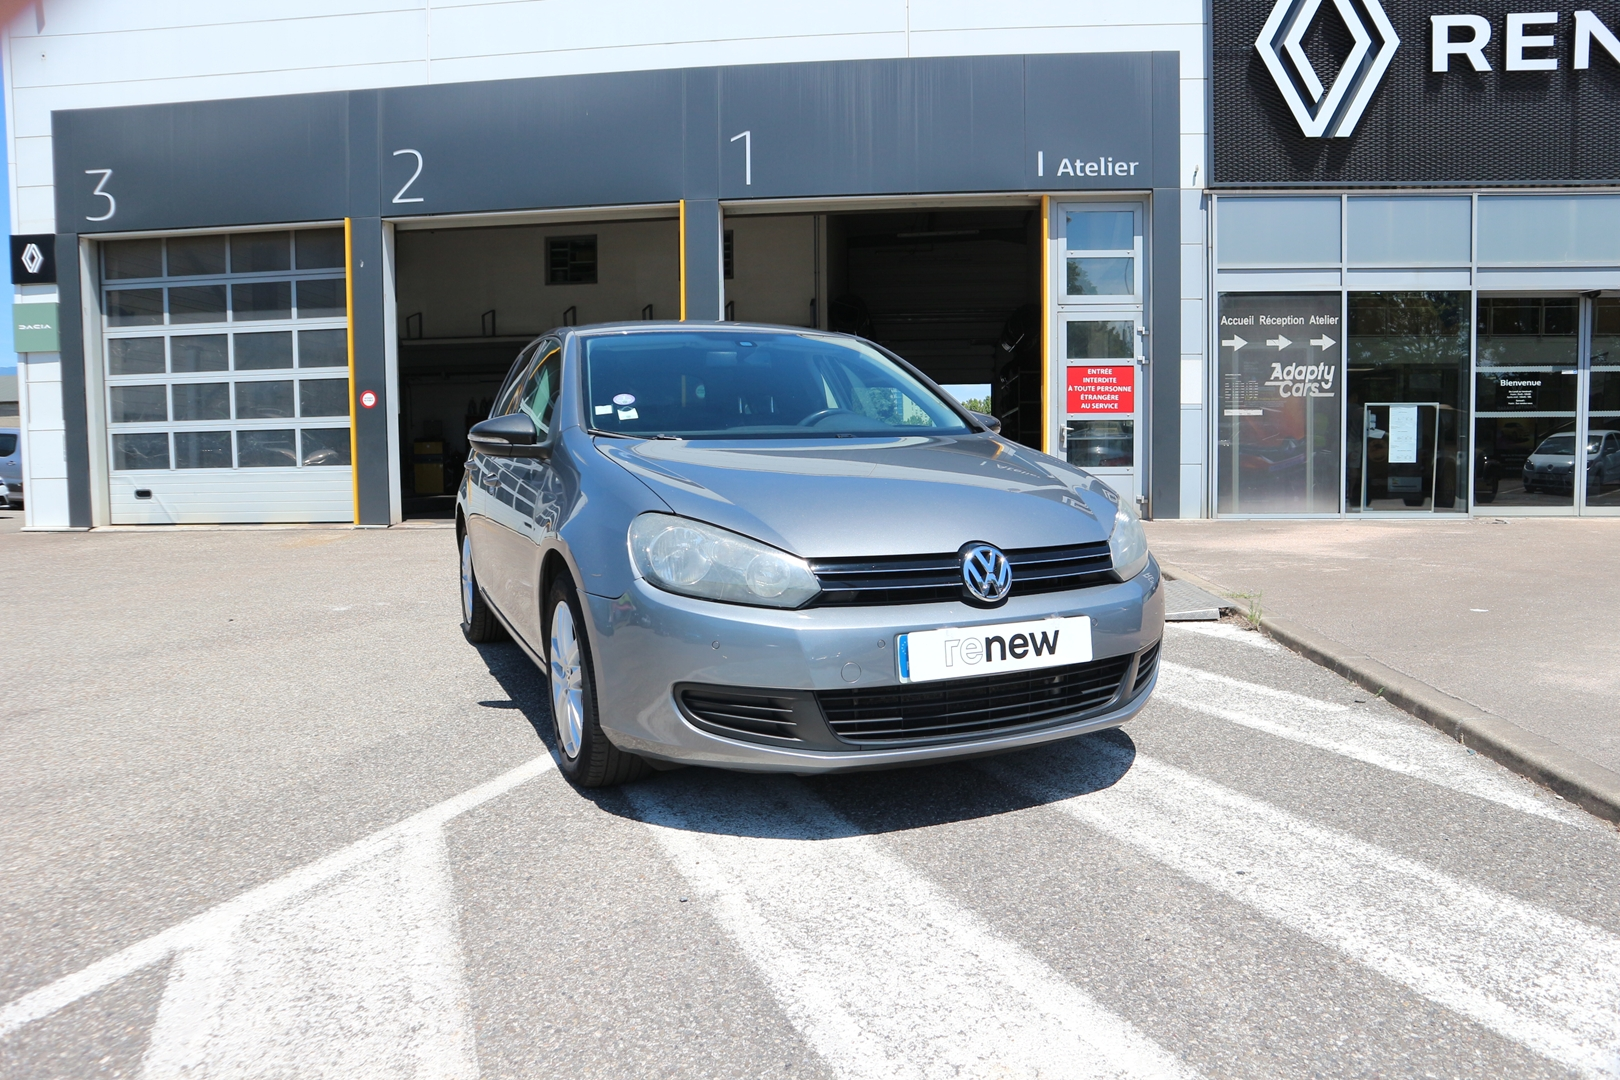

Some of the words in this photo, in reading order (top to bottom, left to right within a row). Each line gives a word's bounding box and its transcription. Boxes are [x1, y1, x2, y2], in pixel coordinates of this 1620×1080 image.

[1430, 9, 1620, 73] REN
[730, 131, 752, 186] 1
[1056, 156, 1140, 177] Atelier
[391, 148, 425, 204] 2
[84, 168, 116, 222] 3
[1220, 315, 1255, 325] Accueil
[1259, 314, 1305, 327] Réception
[1308, 314, 1339, 325] Atelier
[1270, 362, 1335, 389] Adapty
[1501, 379, 1542, 387] Bienvenue
[1080, 393, 1119, 401] ÉTRANGÈRE
[1096, 385, 1132, 393] PERSONNE
[1279, 381, 1320, 398] Cars
[944, 629, 1060, 668] renew
